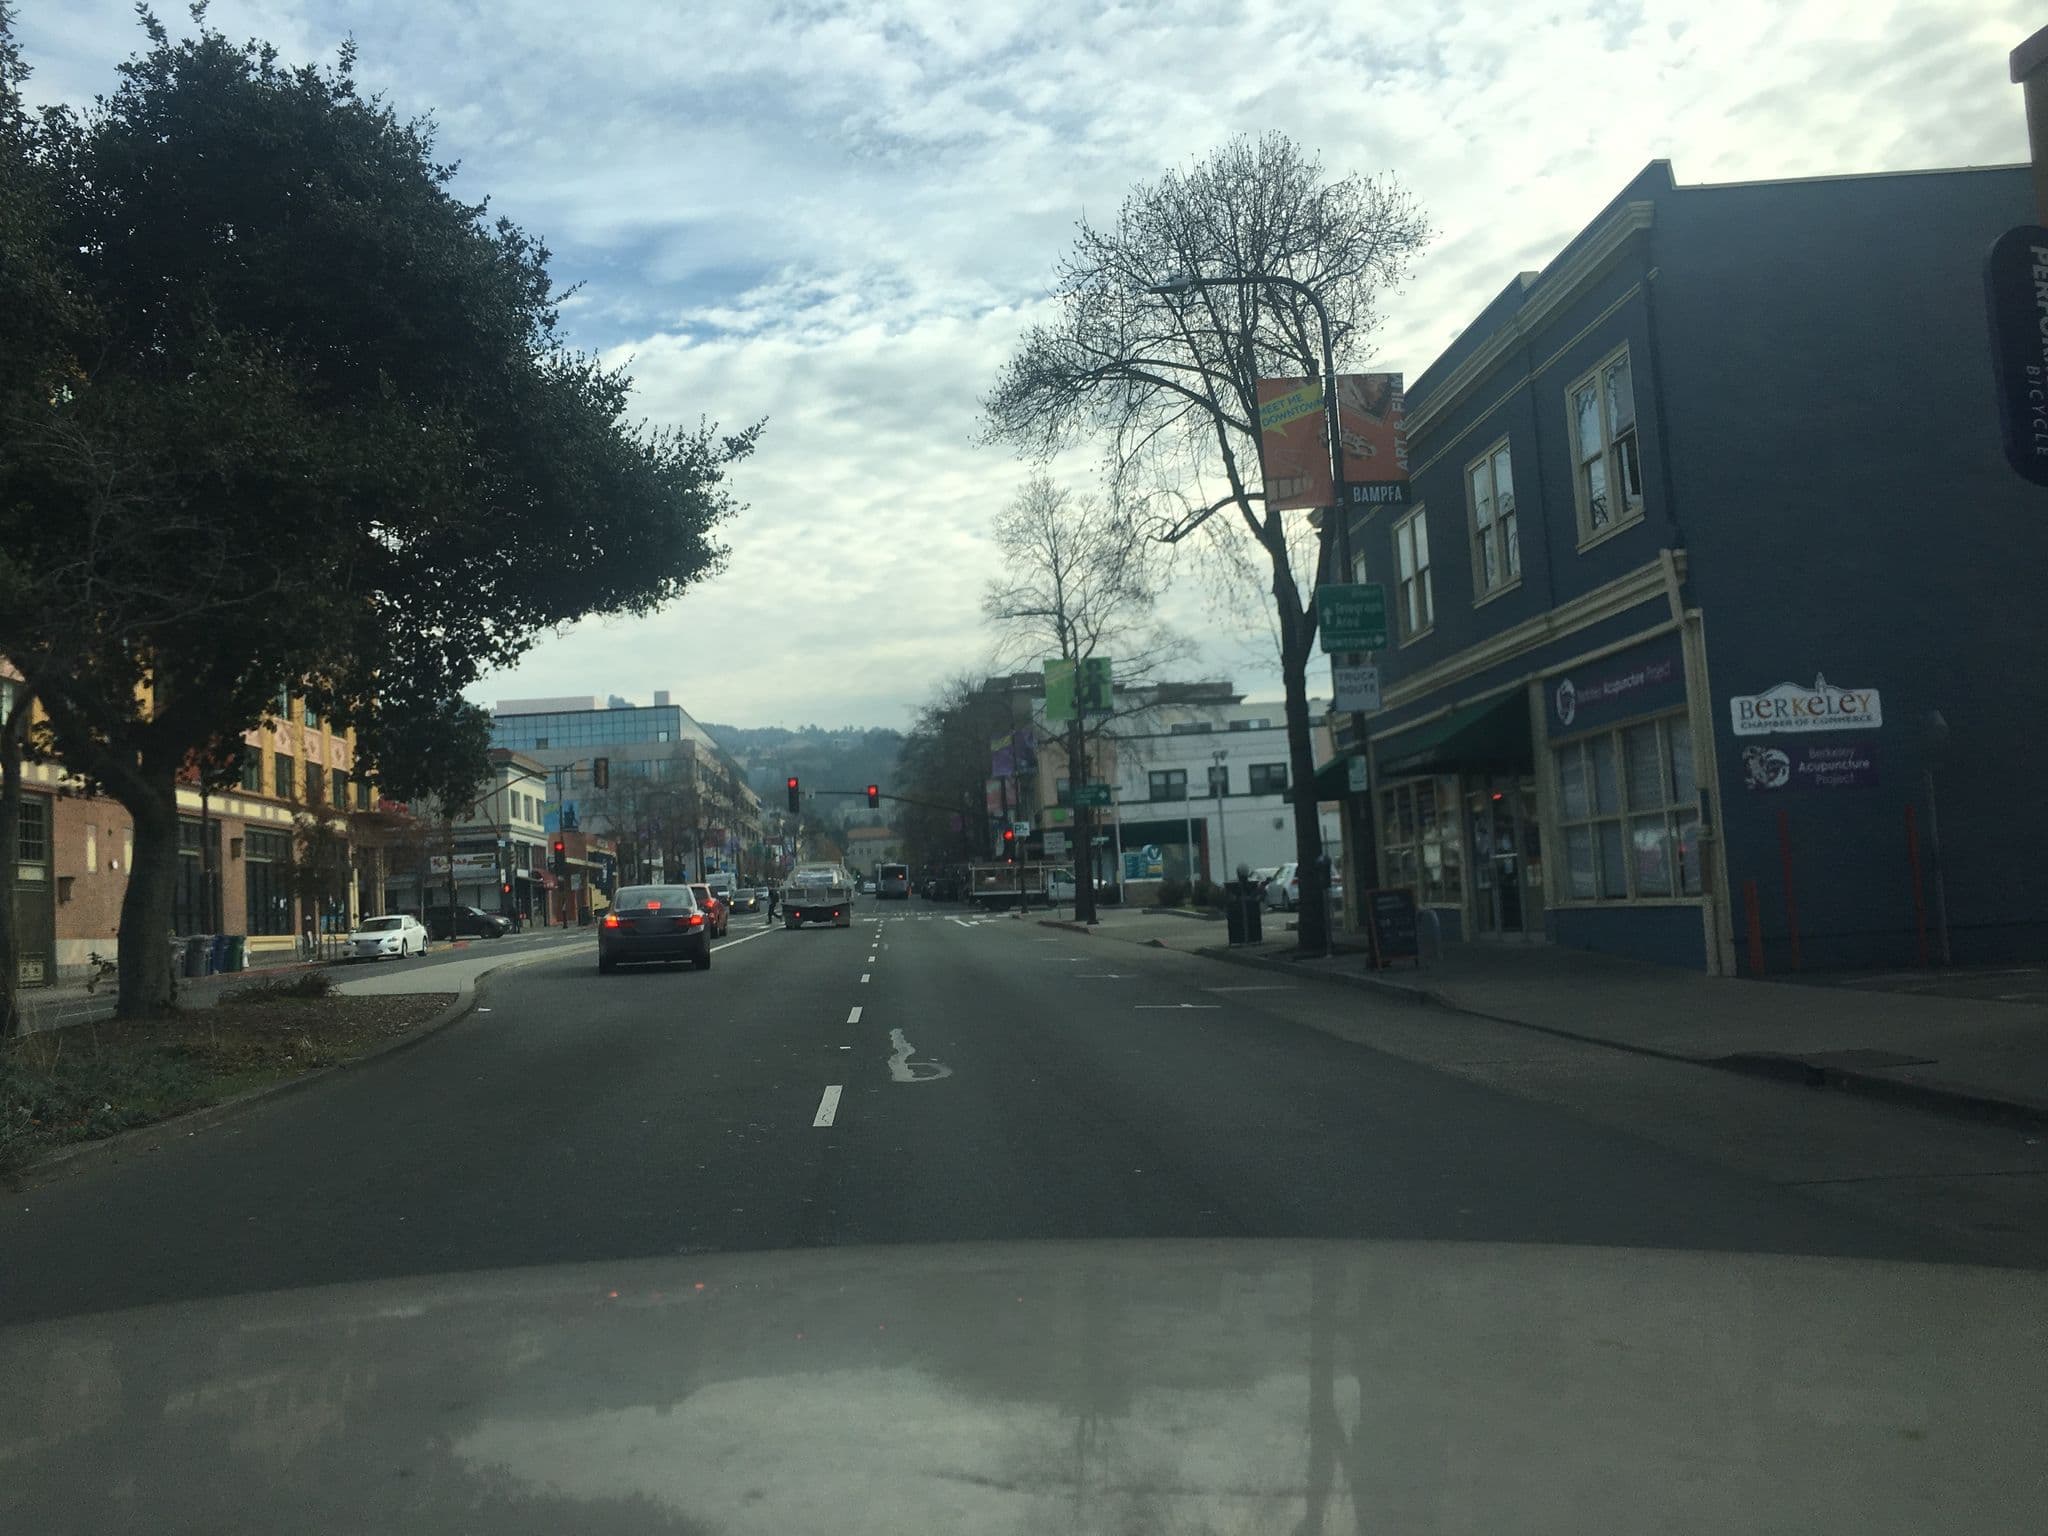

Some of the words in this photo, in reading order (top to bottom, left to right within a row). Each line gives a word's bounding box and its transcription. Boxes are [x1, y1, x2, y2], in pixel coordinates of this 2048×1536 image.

[1260, 400, 1286, 416] MEET
[1288, 393, 1303, 405] ME
[1390, 375, 1404, 412] FILM
[1263, 399, 1325, 427] DOWNTOWN
[2027, 366, 2048, 455] BICYCLE
[1395, 437, 1409, 470] ART
[1352, 485, 1402, 503] BAMPFA
[1741, 719, 1792, 729] CHAMBER
[1795, 718, 1808, 727] OF
[1812, 714, 1873, 725] COMMERCE
[1798, 759, 1871, 773] Acupuncture
